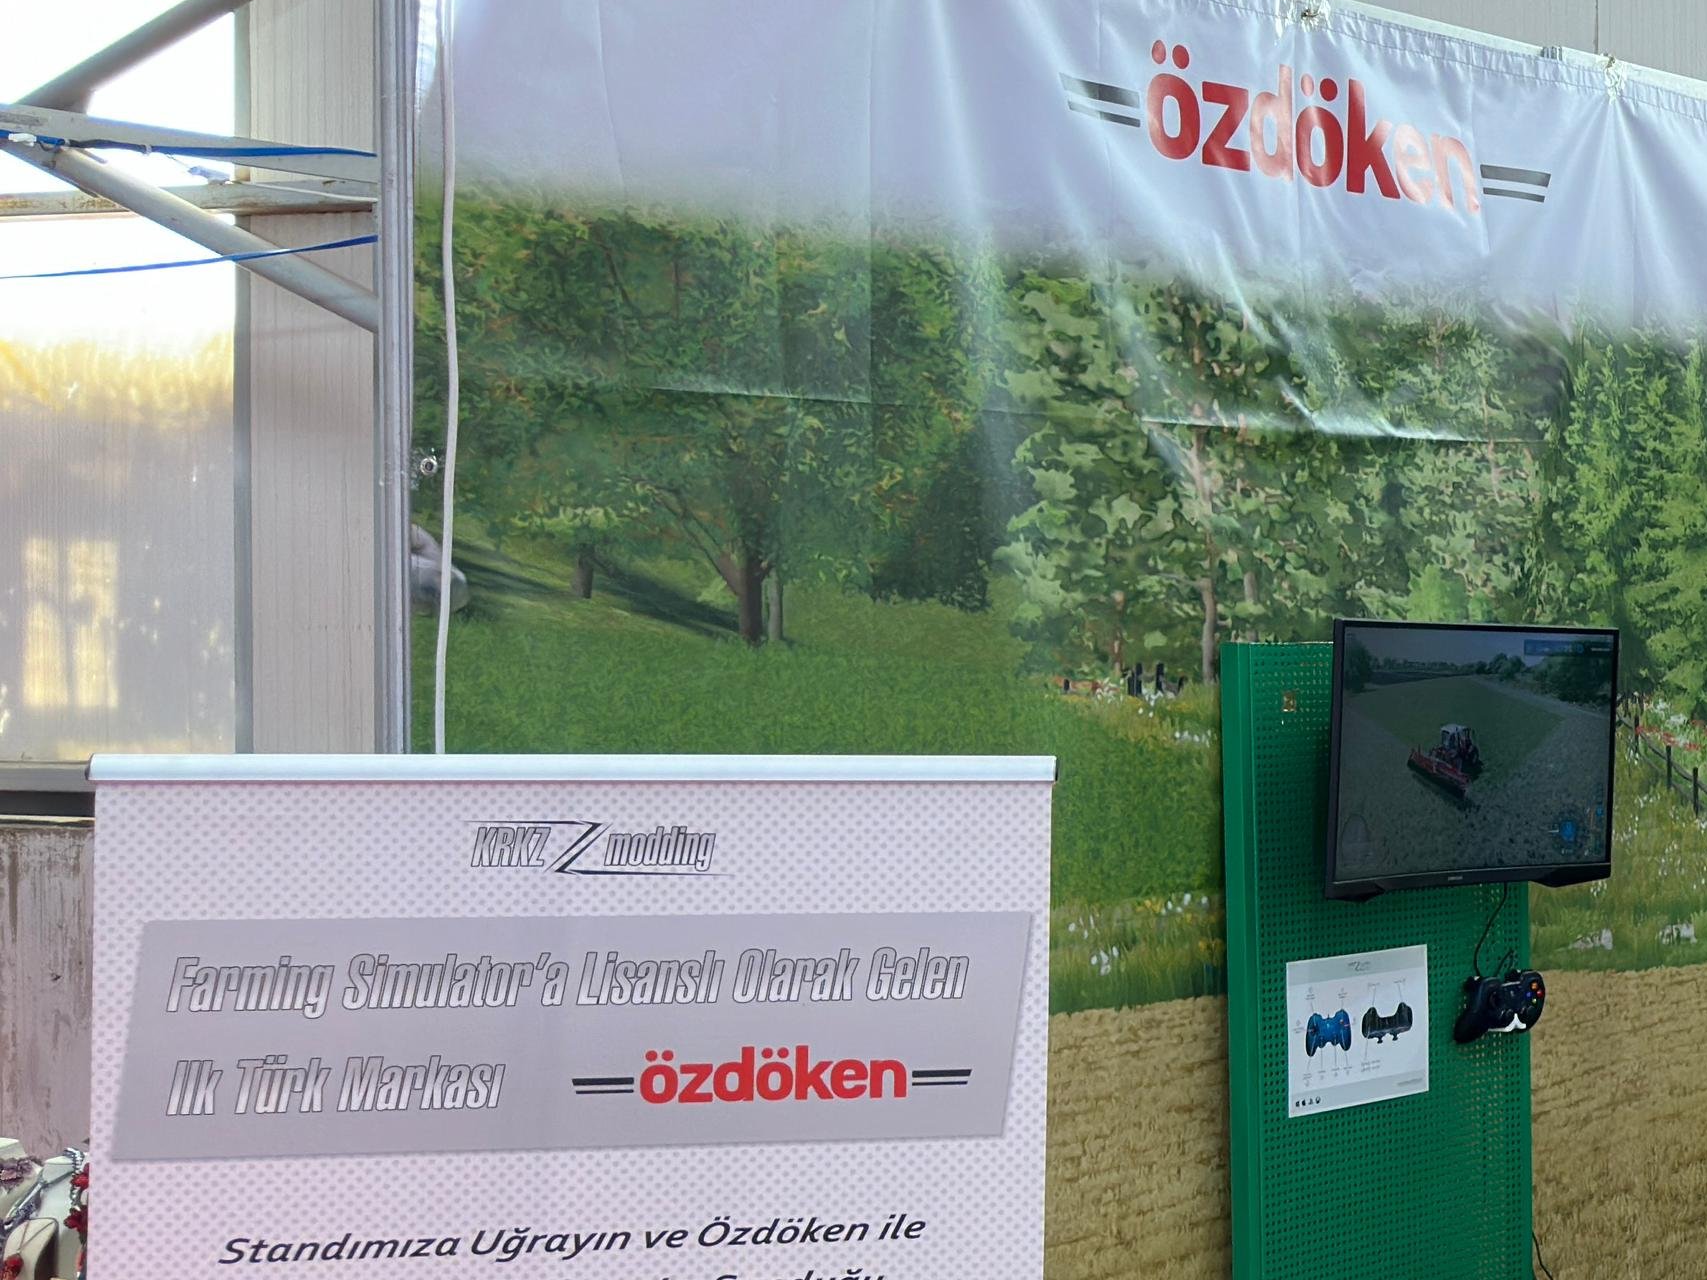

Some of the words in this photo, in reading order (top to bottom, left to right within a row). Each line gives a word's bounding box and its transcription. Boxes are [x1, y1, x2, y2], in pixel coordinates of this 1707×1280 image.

[1147, 39, 1481, 214] özdöken
[470, 826, 551, 867] KRKZ
[604, 826, 716, 872] modding
[166, 955, 335, 1019] Farming
[342, 952, 569, 1009] Simulator'a
[576, 950, 725, 1005] Lisanslı
[732, 948, 859, 1003] Olarak
[866, 946, 969, 1002] Gelen
[234, 1054, 331, 1115] Türk
[336, 1055, 506, 1113] Markası
[639, 1045, 907, 1104] özdöken
[218, 1233, 462, 1265] Standımıza
[470, 1226, 631, 1263] Uğrayın
[645, 1227, 689, 1249] ve
[698, 1216, 870, 1248] Özdöken
[878, 1214, 927, 1241] ile
